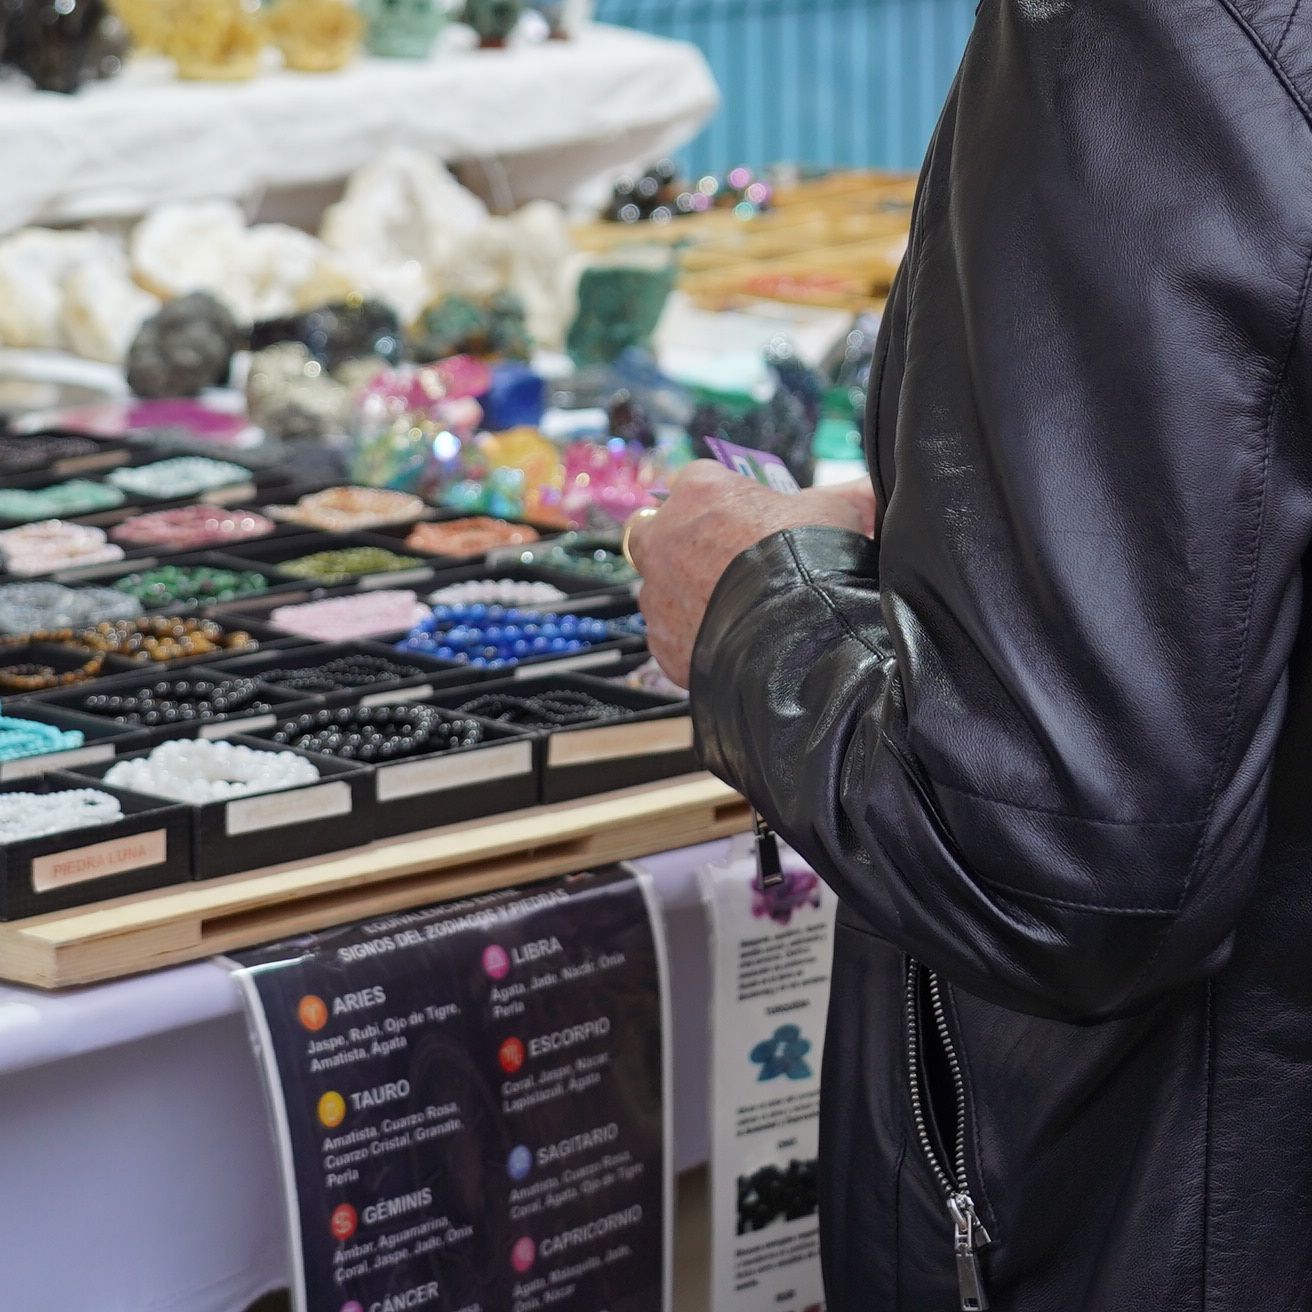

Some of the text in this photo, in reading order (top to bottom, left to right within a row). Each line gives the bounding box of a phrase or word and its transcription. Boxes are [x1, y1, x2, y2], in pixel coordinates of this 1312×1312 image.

[53, 845, 146, 877] PIEDRA LUNA
[338, 936, 395, 962] SIGNOS
[394, 929, 425, 948] DEL
[510, 888, 570, 917] PIEDRAS
[511, 936, 563, 965] LIBRA
[333, 986, 386, 1014] ARIES
[308, 1035, 349, 1055] Jaspe,
[383, 1017, 407, 1033] Ojo
[408, 1010, 425, 1024] de
[424, 1003, 461, 1021] Tigre,
[528, 1016, 611, 1057] ESCORPIO
[310, 1048, 369, 1073] Amatista,
[350, 1079, 410, 1110] TAURO
[323, 1126, 380, 1152] Amatista,
[381, 1112, 425, 1132] Cuarzo
[537, 1122, 619, 1165] SAGITARIO
[324, 1148, 369, 1169] Cuarzo
[325, 1168, 359, 1187] Perla
[363, 1188, 433, 1224] GÉMINIS
[539, 1203, 643, 1257] CAPRICORNIO
[334, 1261, 371, 1282] Coral,
